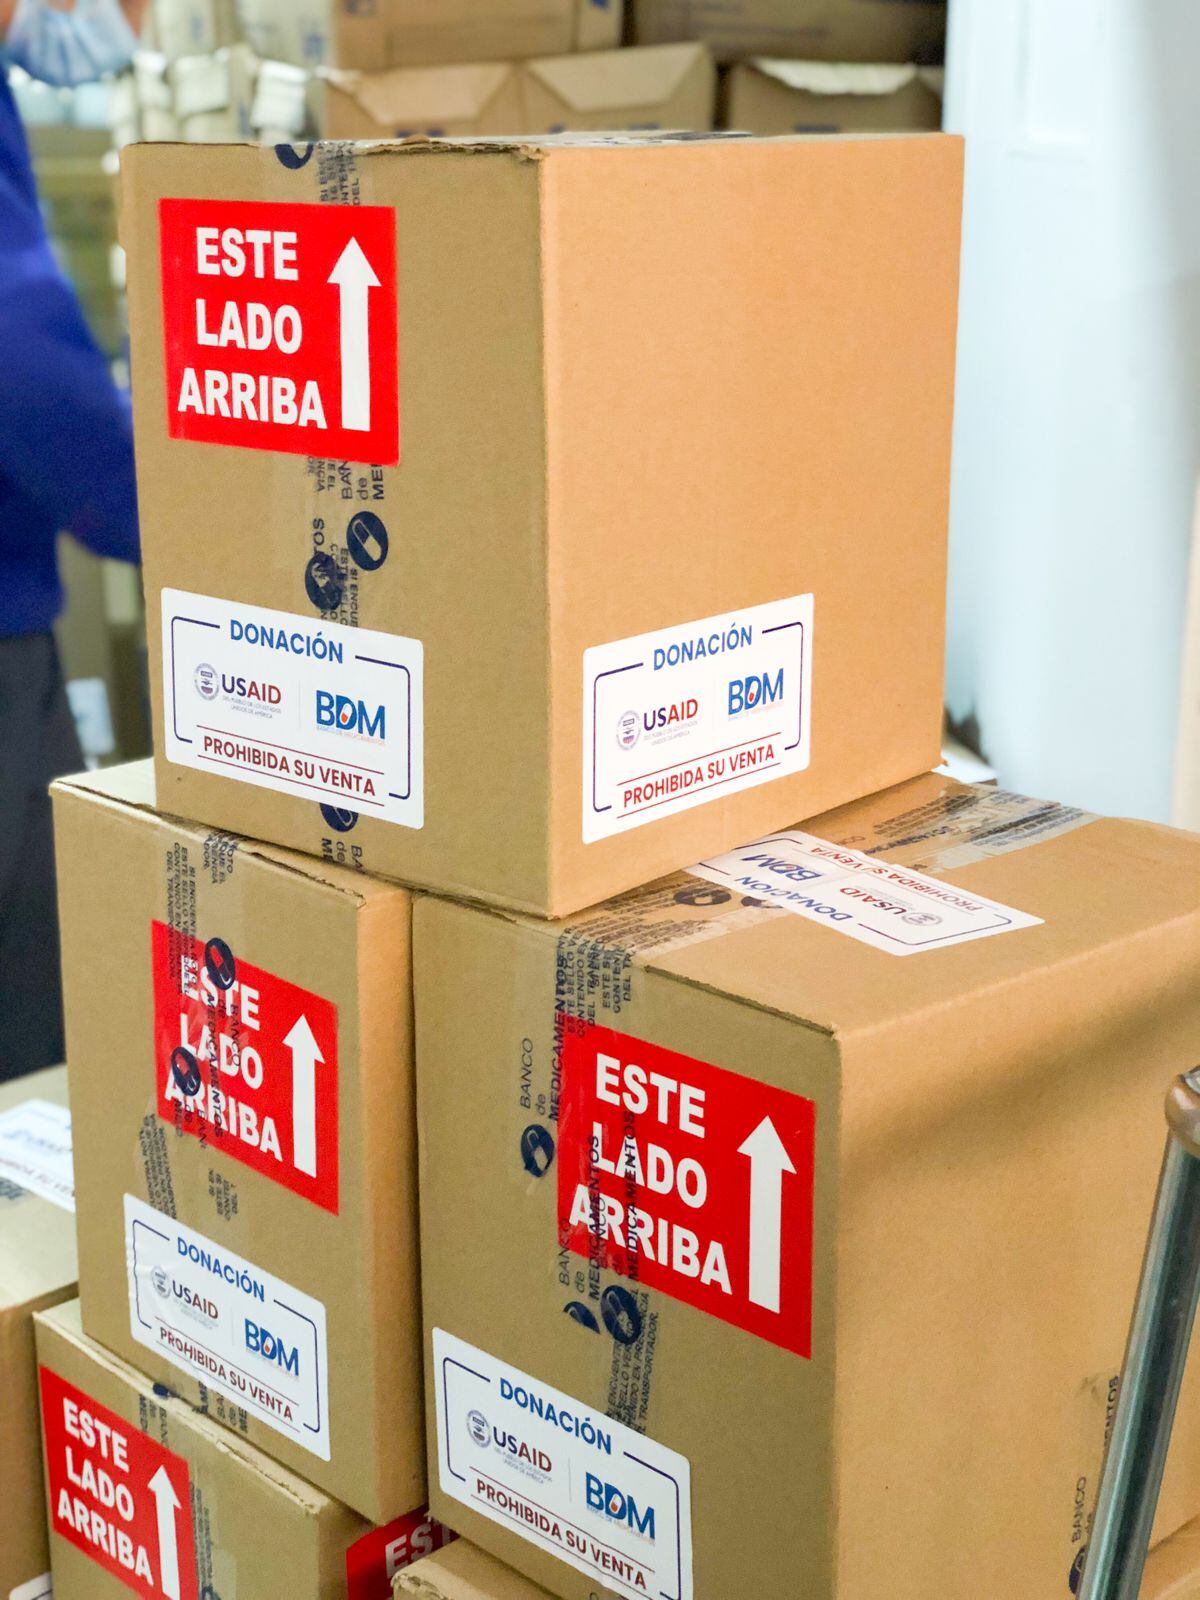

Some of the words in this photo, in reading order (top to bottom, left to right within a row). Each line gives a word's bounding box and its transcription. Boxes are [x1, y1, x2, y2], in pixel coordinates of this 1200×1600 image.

[196, 227, 299, 280] ESTE
[196, 298, 302, 354] LADO
[178, 368, 328, 429] ARRIBA
[230, 619, 343, 663] DONACIÓN
[654, 622, 752, 671] DONACIÓN
[221, 674, 281, 705] USAID
[316, 690, 386, 739] BDM
[643, 698, 698, 731] USAID
[728, 668, 784, 715] BDM
[204, 735, 290, 773] PROHIBIDA
[294, 759, 315, 779] SU
[319, 767, 376, 796] VENTA
[624, 766, 704, 808] PROHIBIDA
[708, 756, 725, 780] SU
[729, 744, 775, 772] VENTA
[741, 854, 822, 881] BDM
[811, 847, 860, 870] VENTA
[735, 876, 853, 921] DONACIÓN
[840, 887, 907, 915] USAID
[887, 873, 981, 912] PROHIBIDA
[181, 955, 260, 1031] ESTE
[566, 952, 575, 995] SELLO
[577, 959, 586, 1038] CONTENIDO
[602, 974, 611, 1009] ESTE
[623, 975, 632, 1002] DEL
[587, 1001, 596, 1027] DEL
[180, 1013, 263, 1089] LADO
[520, 1038, 534, 1109] BANCO
[535, 1093, 546, 1116] de
[596, 1052, 706, 1139] ESTE
[592, 1121, 707, 1209] LADO
[588, 1136, 600, 1301] MEDICAMENTOS
[623, 1111, 640, 1280] MEDICAMENTOS
[569, 1184, 733, 1295] ARRIBA
[177, 1237, 265, 1302] DONACIÓN
[574, 1271, 585, 1293] de
[172, 1280, 219, 1320] USAID
[160, 1326, 227, 1377] PROHIBIDA
[229, 1371, 247, 1390] SU
[248, 1382, 293, 1421] VENTA
[244, 1318, 299, 1376] BDM
[63, 1397, 130, 1473] ESTE
[500, 1377, 612, 1455] DONACIÓN
[493, 1426, 552, 1473] USAID
[65, 1446, 134, 1522] LADO
[585, 1471, 655, 1540] BDM
[57, 1488, 154, 1586] ARRIBA
[476, 1478, 562, 1541] PROHIBIDA
[565, 1530, 587, 1554] SU
[590, 1544, 647, 1590] VENTA
